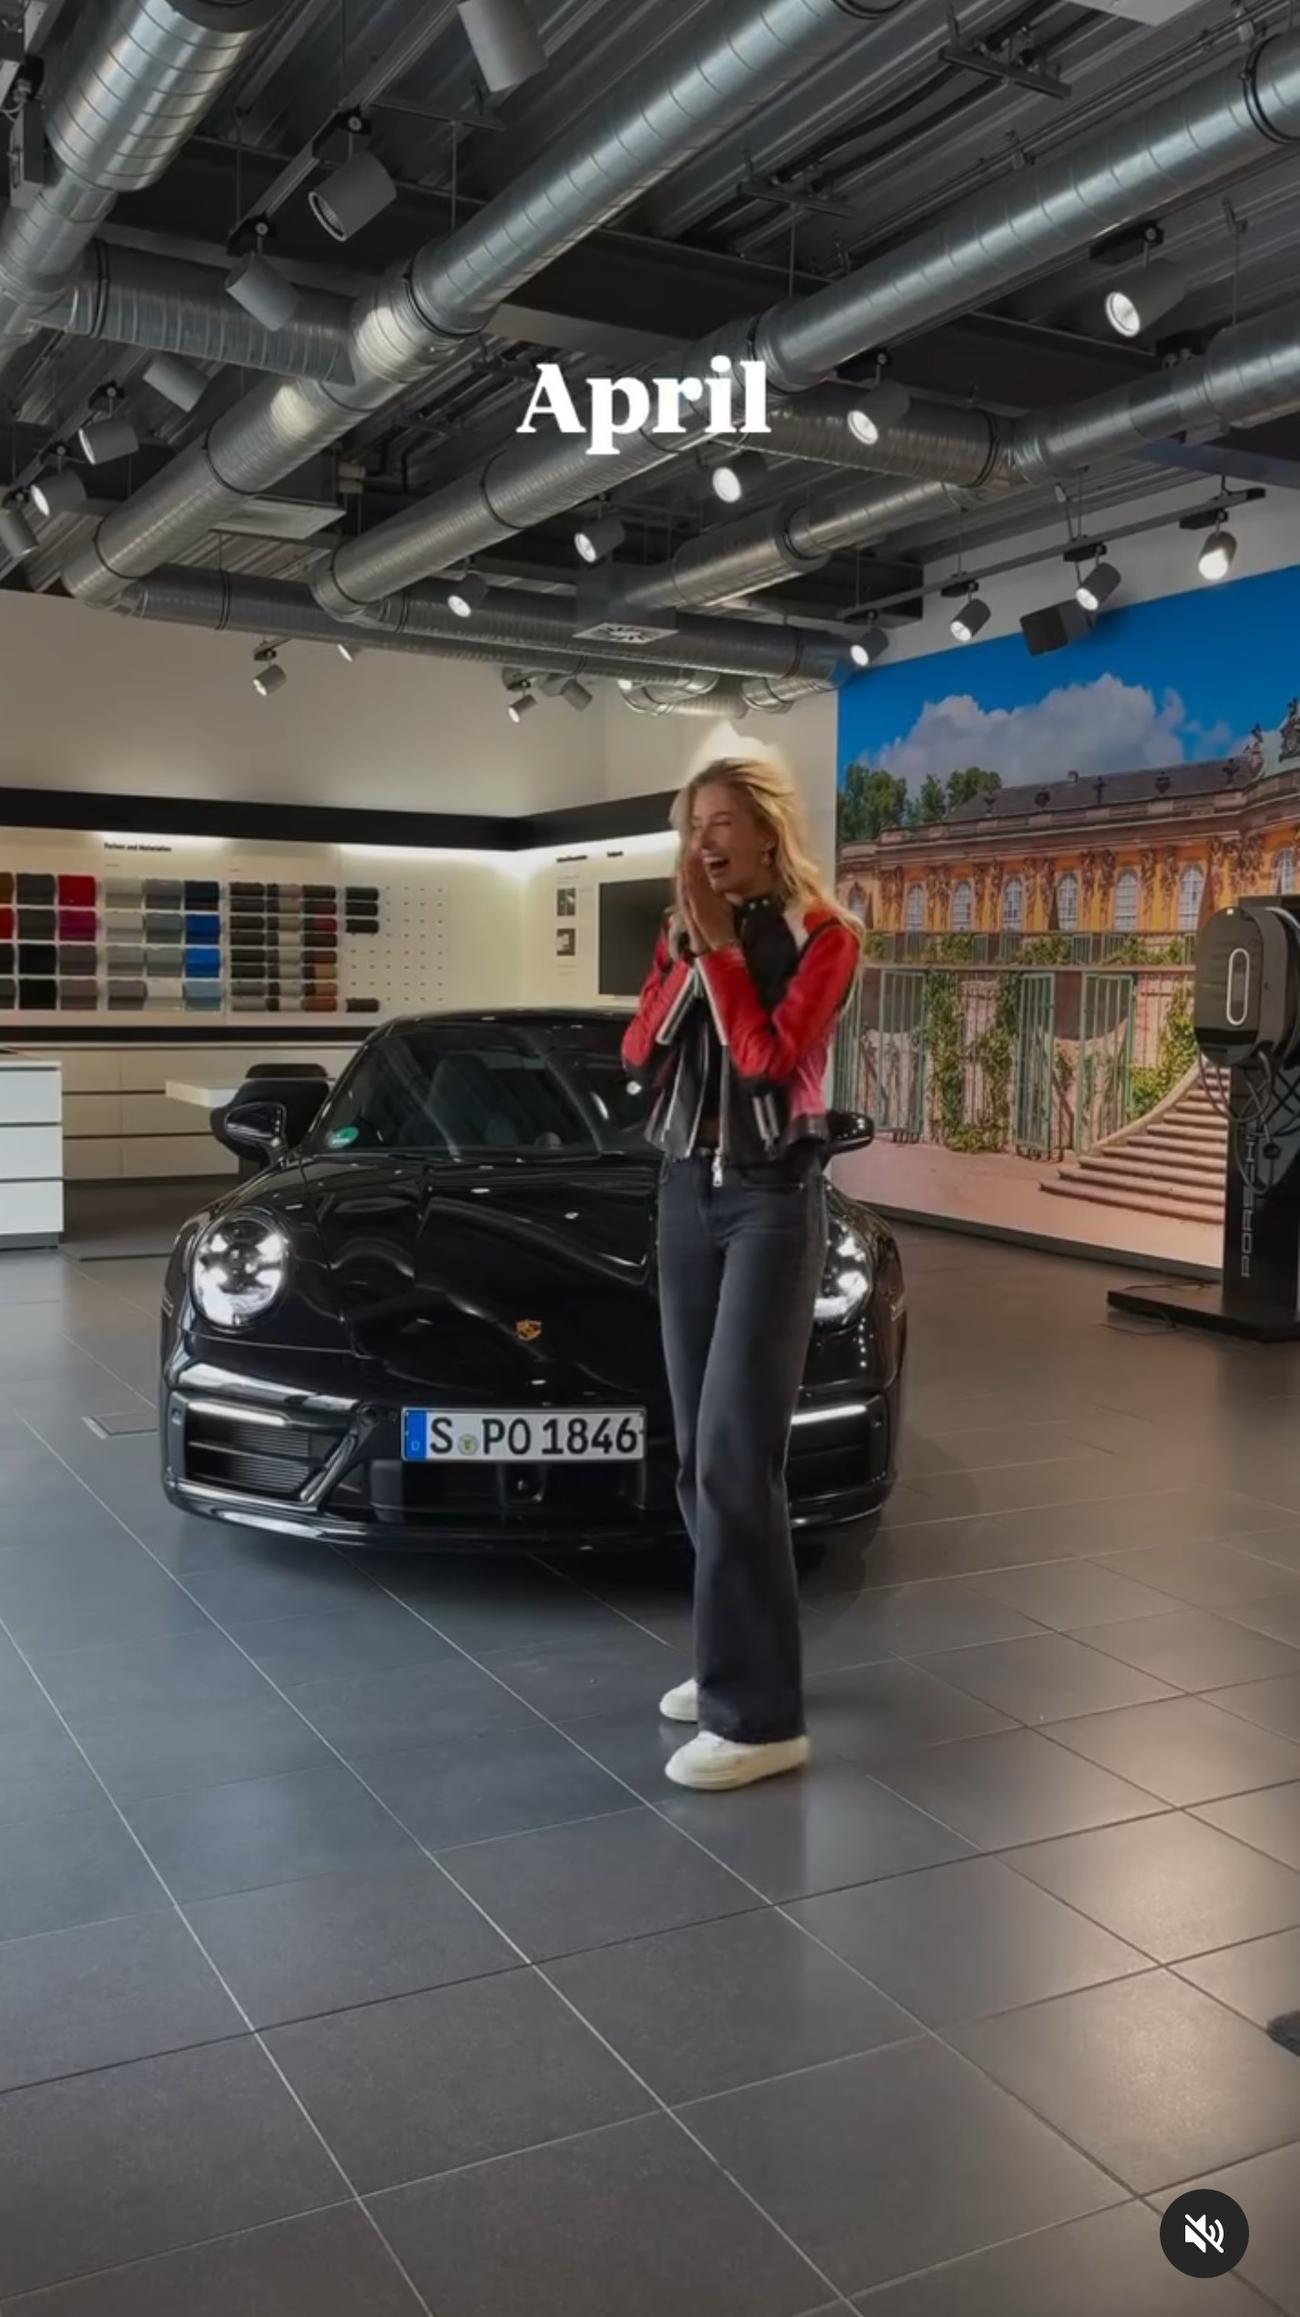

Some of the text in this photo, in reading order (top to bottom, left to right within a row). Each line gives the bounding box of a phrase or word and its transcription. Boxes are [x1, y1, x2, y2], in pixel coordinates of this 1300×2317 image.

[1241, 1119, 1257, 1278] PORSCH
[430, 1417, 453, 1454] S
[482, 1417, 532, 1455] PO
[541, 1417, 638, 1455] 1846
